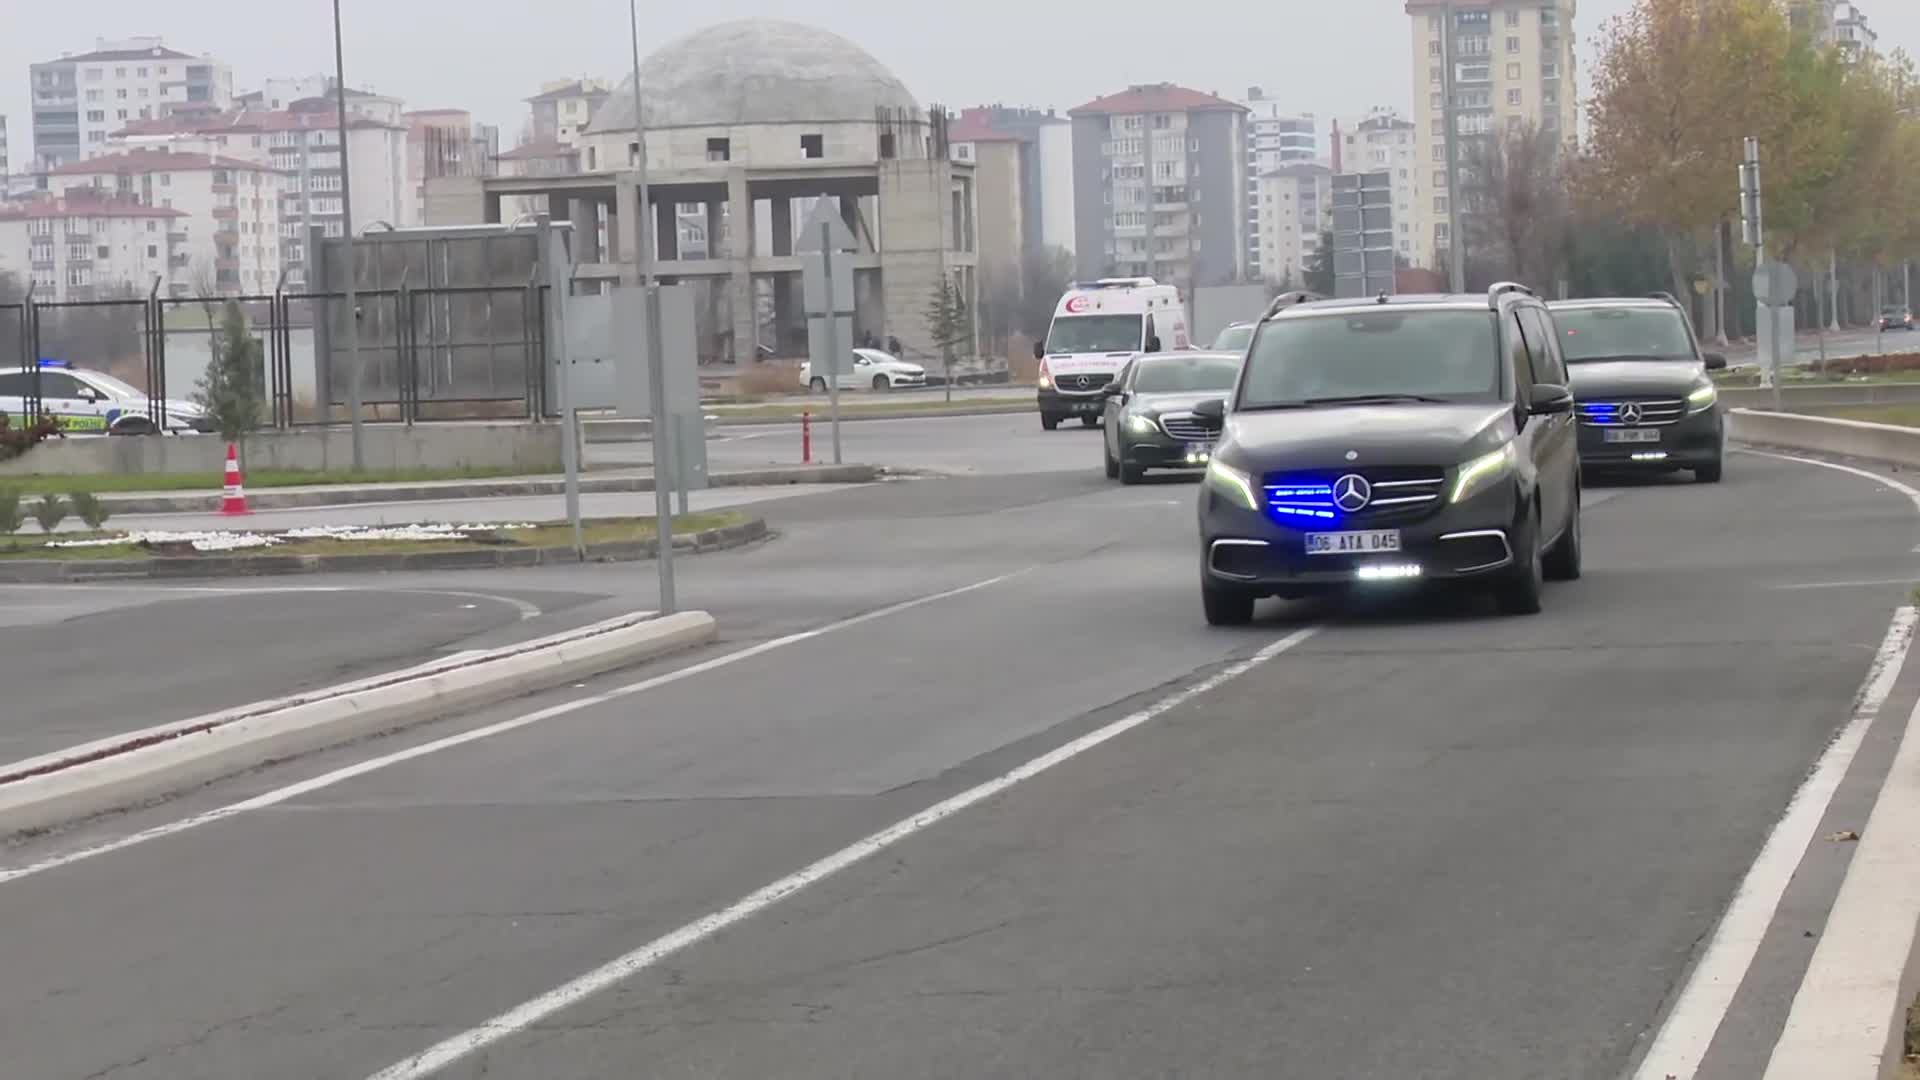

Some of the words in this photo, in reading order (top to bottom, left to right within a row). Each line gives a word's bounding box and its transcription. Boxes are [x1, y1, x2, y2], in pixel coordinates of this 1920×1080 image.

[1316, 536, 1330, 551] 06
[1339, 535, 1363, 550] ATA
[1372, 534, 1397, 549] 045
